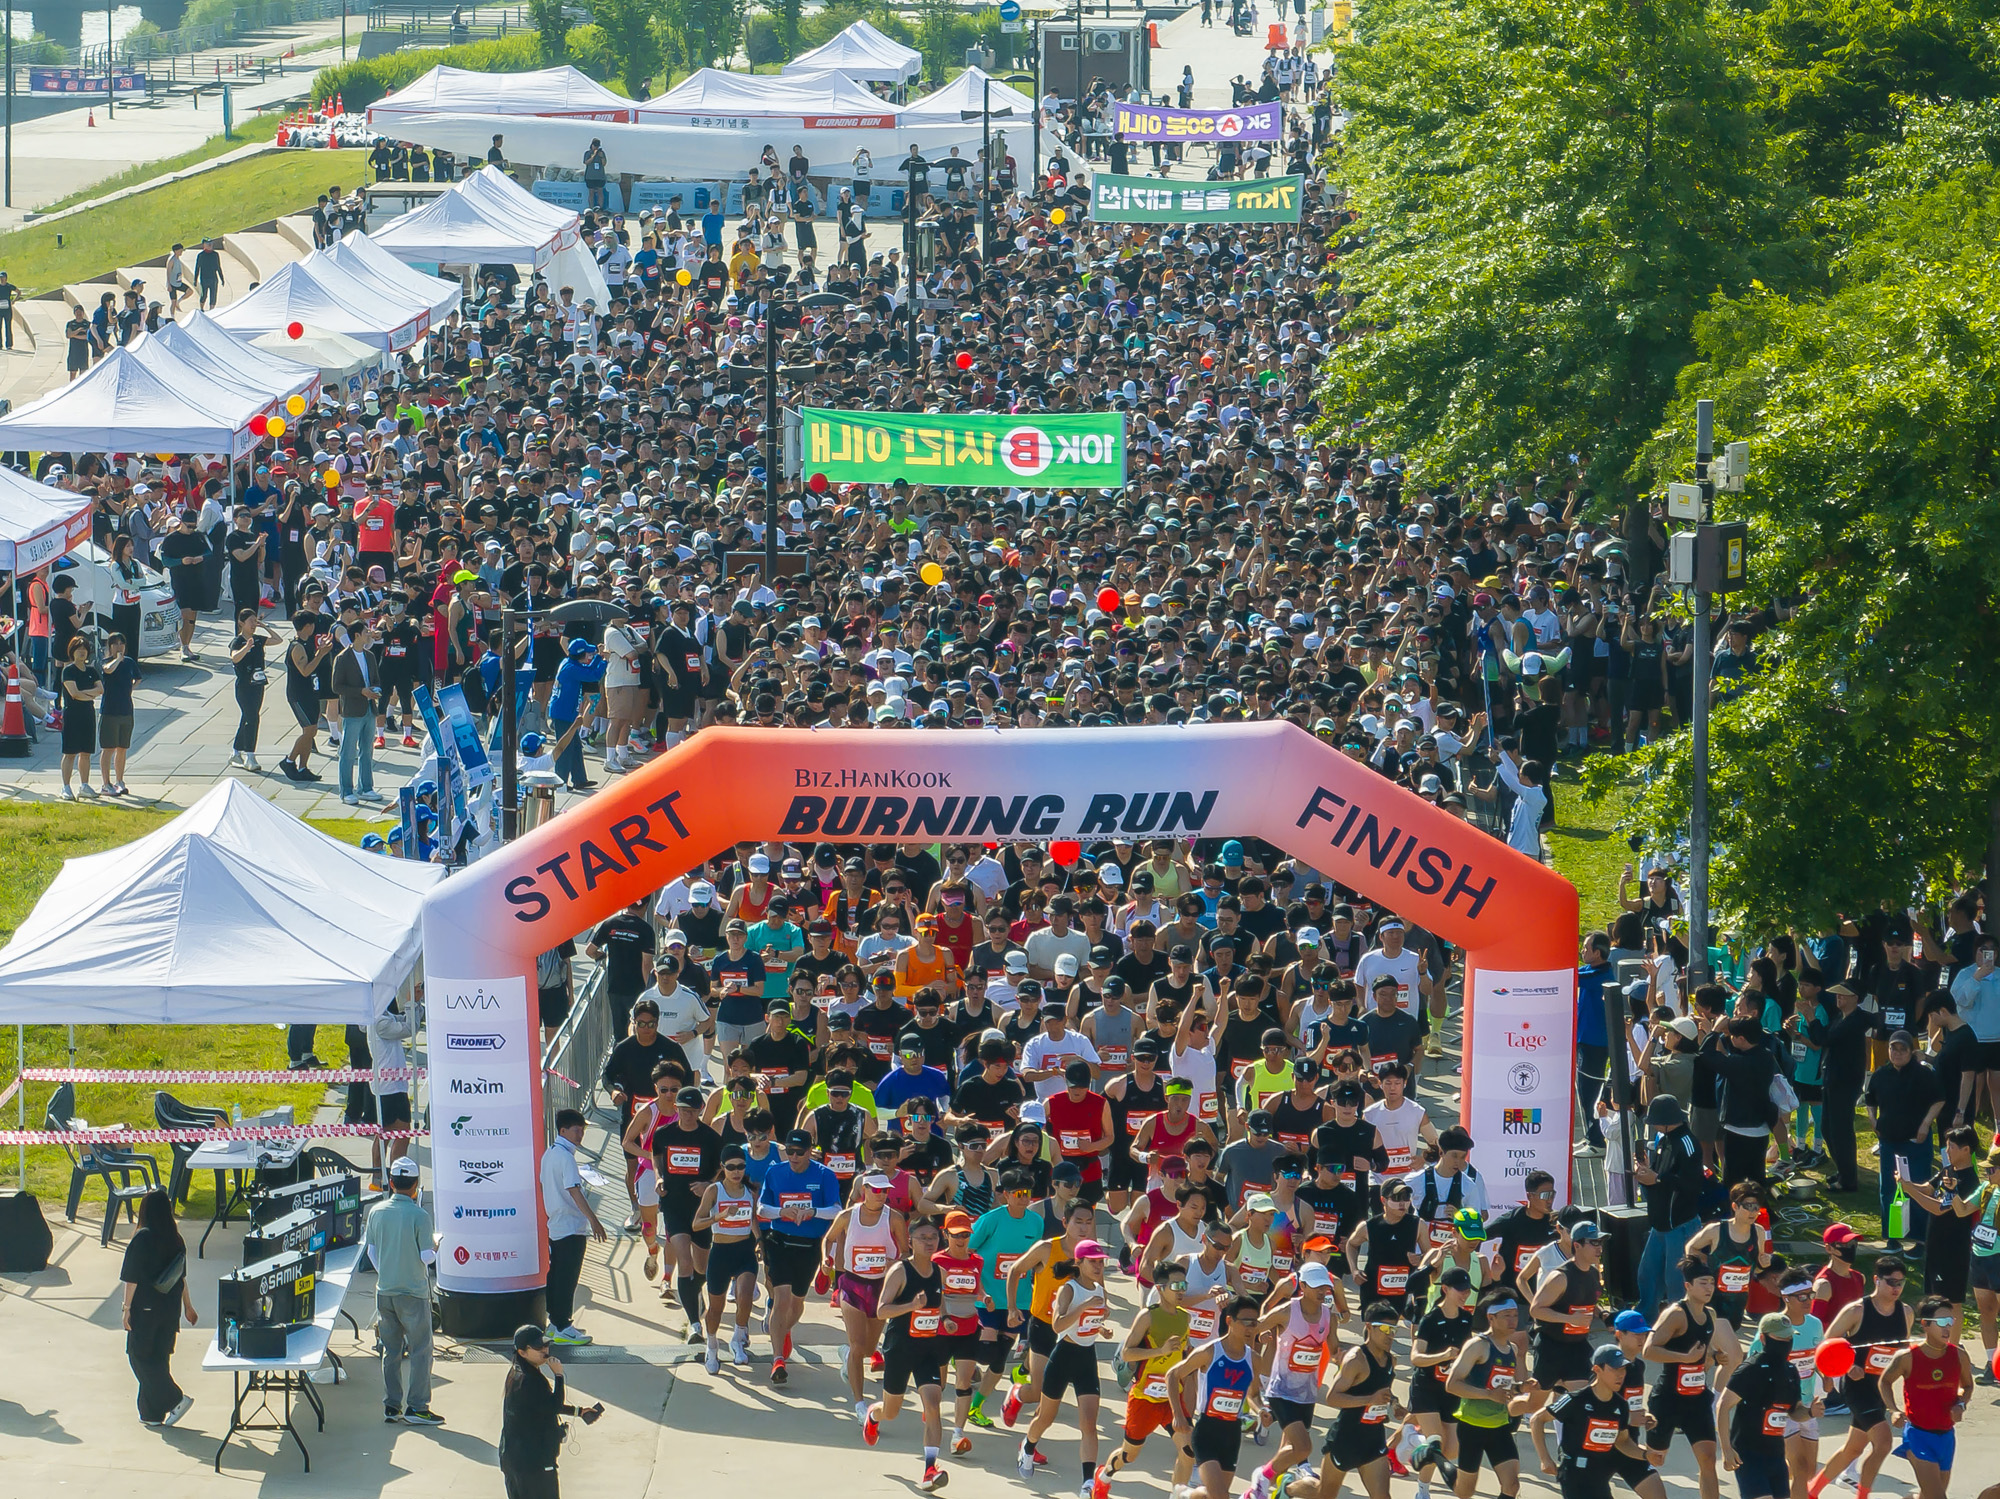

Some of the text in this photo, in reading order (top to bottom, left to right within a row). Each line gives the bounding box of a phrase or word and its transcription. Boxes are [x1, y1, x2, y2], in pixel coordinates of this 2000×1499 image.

[815, 118, 882, 127] BURNING RUN
[777, 789, 1221, 837] BURNING RUN
[504, 790, 691, 922] START
[1295, 785, 1498, 920] FINISH
[450, 1038, 498, 1047] FAVONEX
[1504, 1031, 1548, 1053] Tage
[450, 1077, 504, 1094] Maxim
[464, 1127, 511, 1136] NEWTREE
[1502, 1122, 1542, 1135] KIND
[1506, 1149, 1536, 1159] TOUS
[459, 1159, 505, 1170] Reebok
[302, 1184, 345, 1208] SAMIK
[338, 1197, 356, 1209] 10km
[289, 1221, 317, 1248] SAMIK
[268, 1263, 303, 1290] SAMIK
